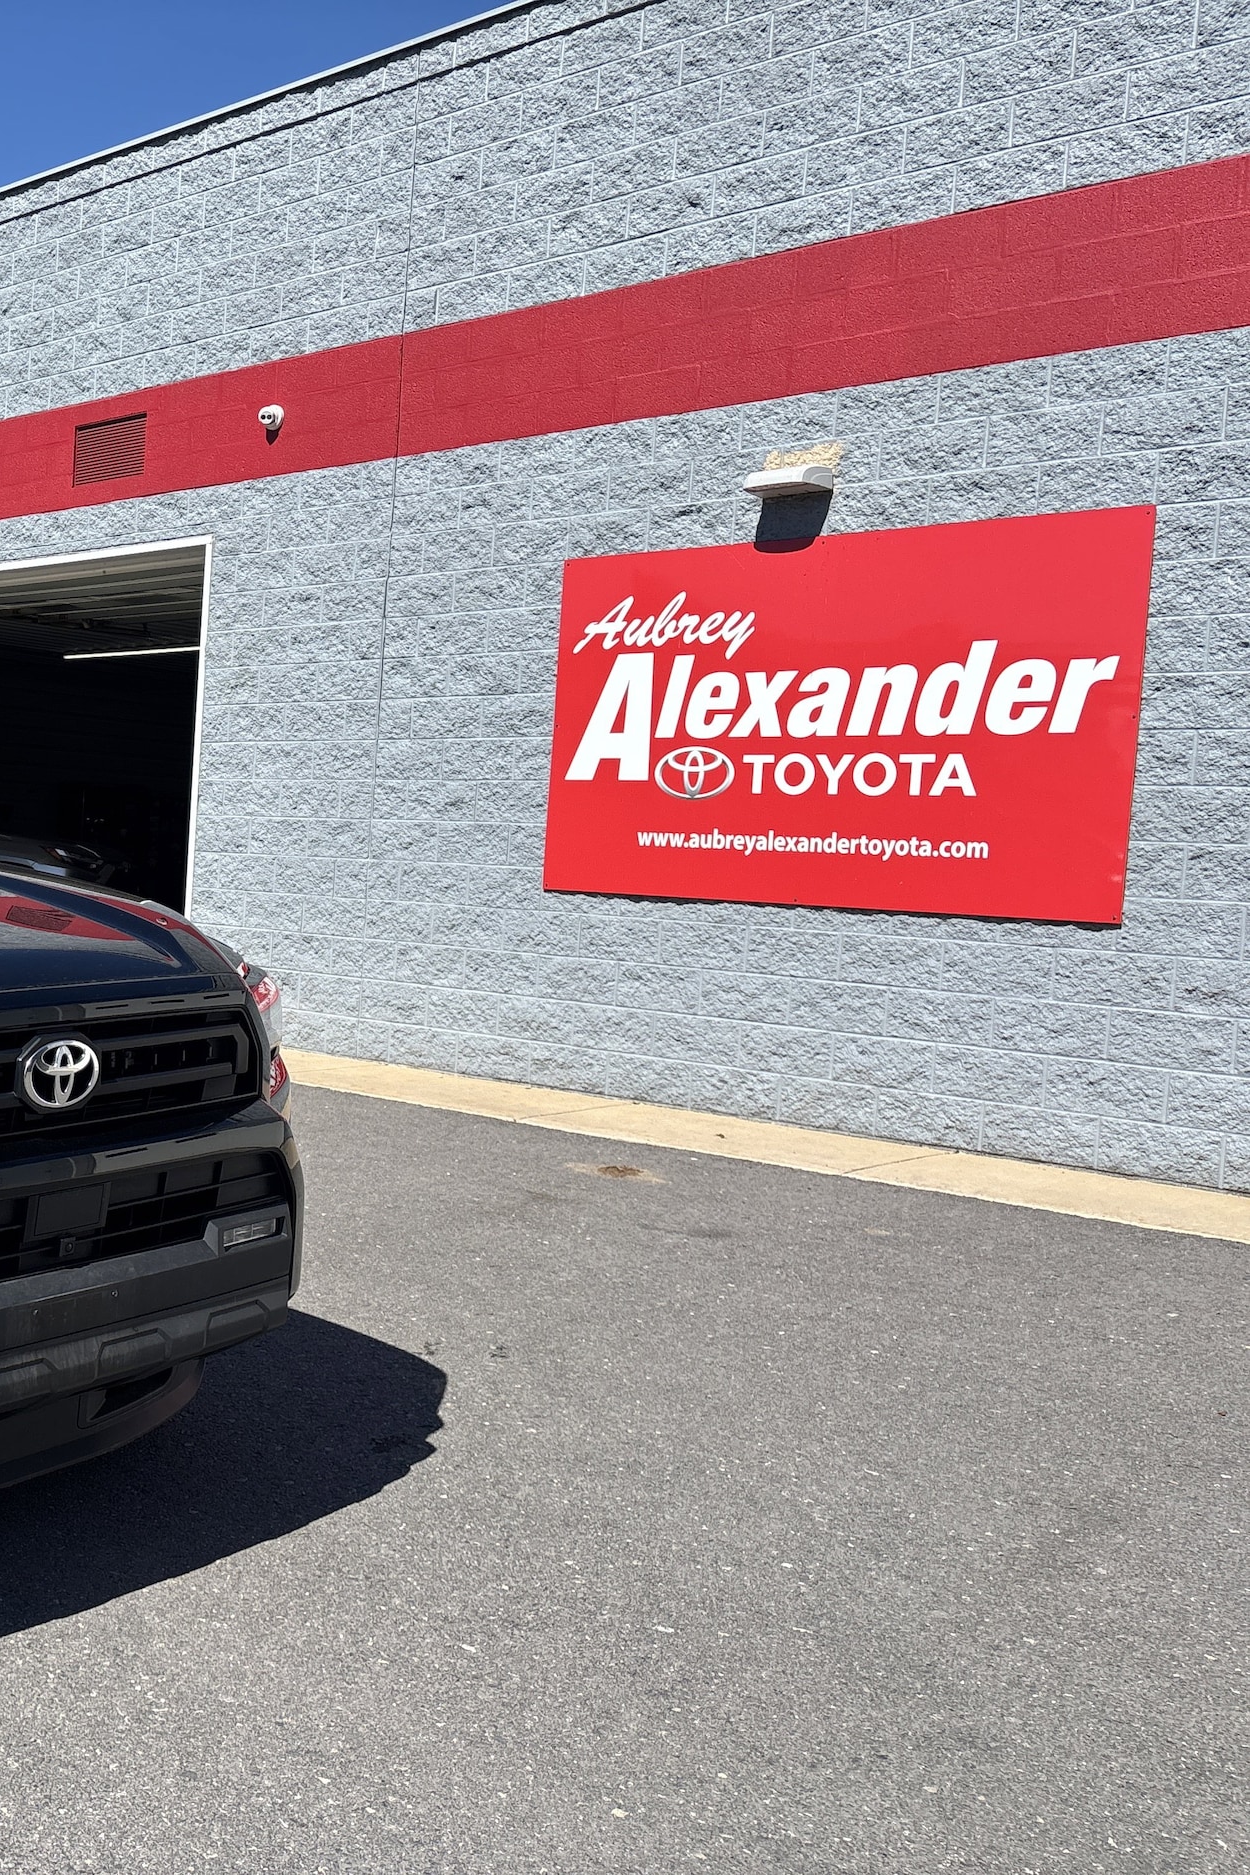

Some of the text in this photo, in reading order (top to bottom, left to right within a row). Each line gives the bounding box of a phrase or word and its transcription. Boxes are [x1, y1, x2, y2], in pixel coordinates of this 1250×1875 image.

[572, 590, 756, 661] Aubrey
[564, 639, 1121, 782] Alexander
[742, 752, 978, 797] TOYOTA
[636, 827, 990, 861] www.aubreyalexandertoyota.com
